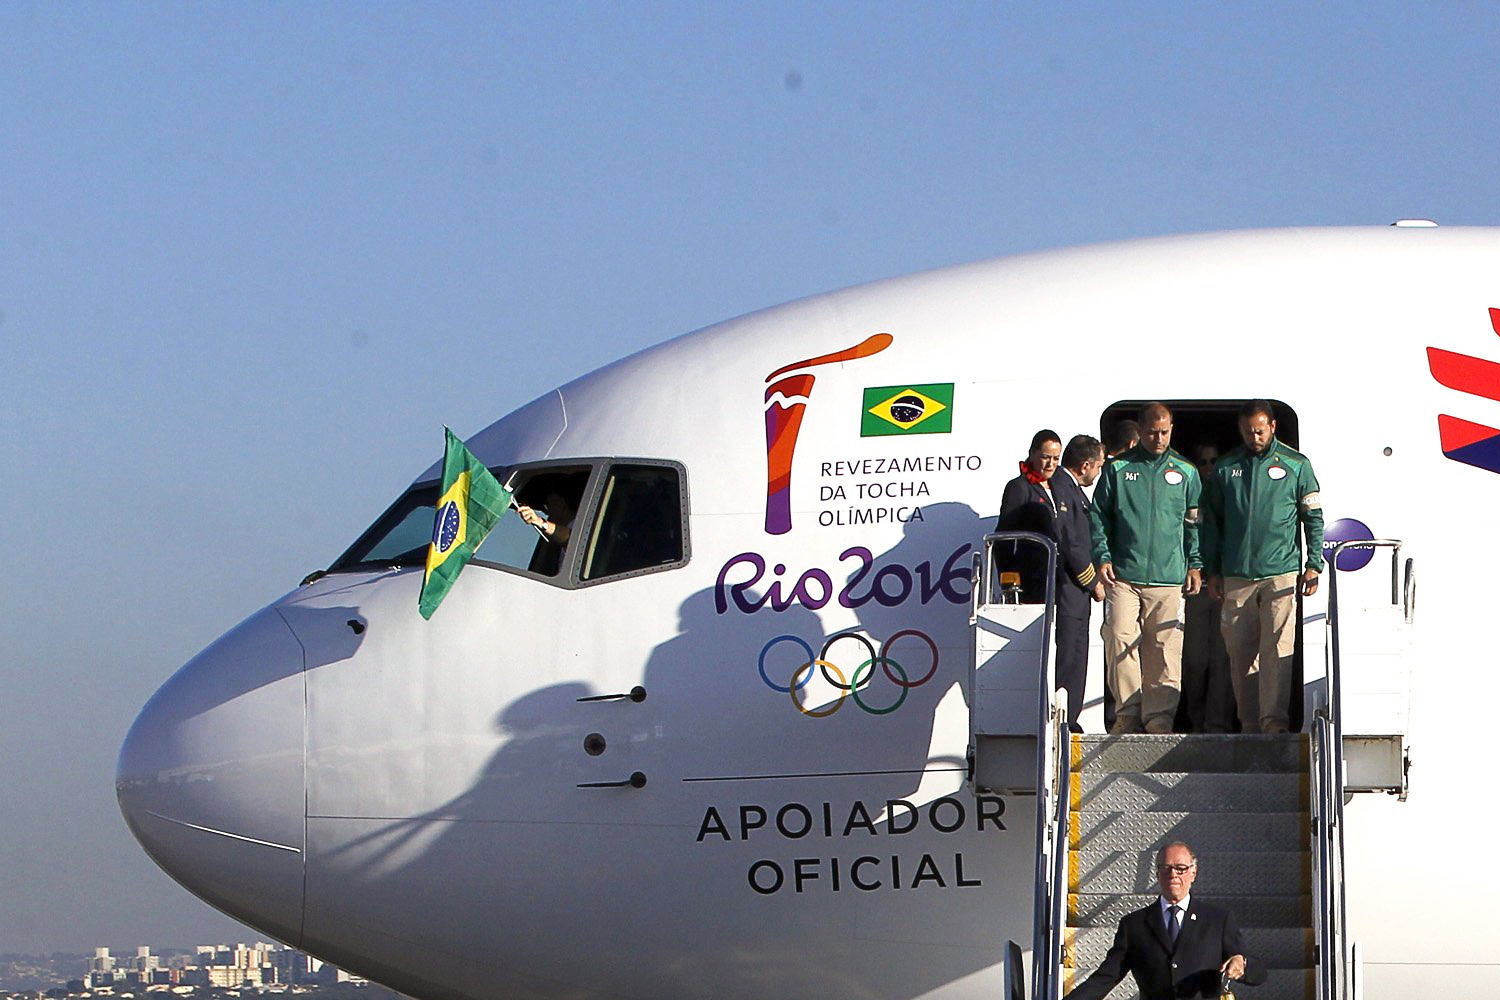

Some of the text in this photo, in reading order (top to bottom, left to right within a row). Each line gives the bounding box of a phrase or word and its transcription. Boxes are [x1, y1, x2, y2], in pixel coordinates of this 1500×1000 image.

[820, 455, 982, 478] REVEZAMENTO
[819, 481, 931, 502] DA TOCHA
[818, 505, 925, 527] OLÍMPICA
[696, 796, 1008, 842] APOIADOR
[747, 853, 982, 895] OFICIAL
